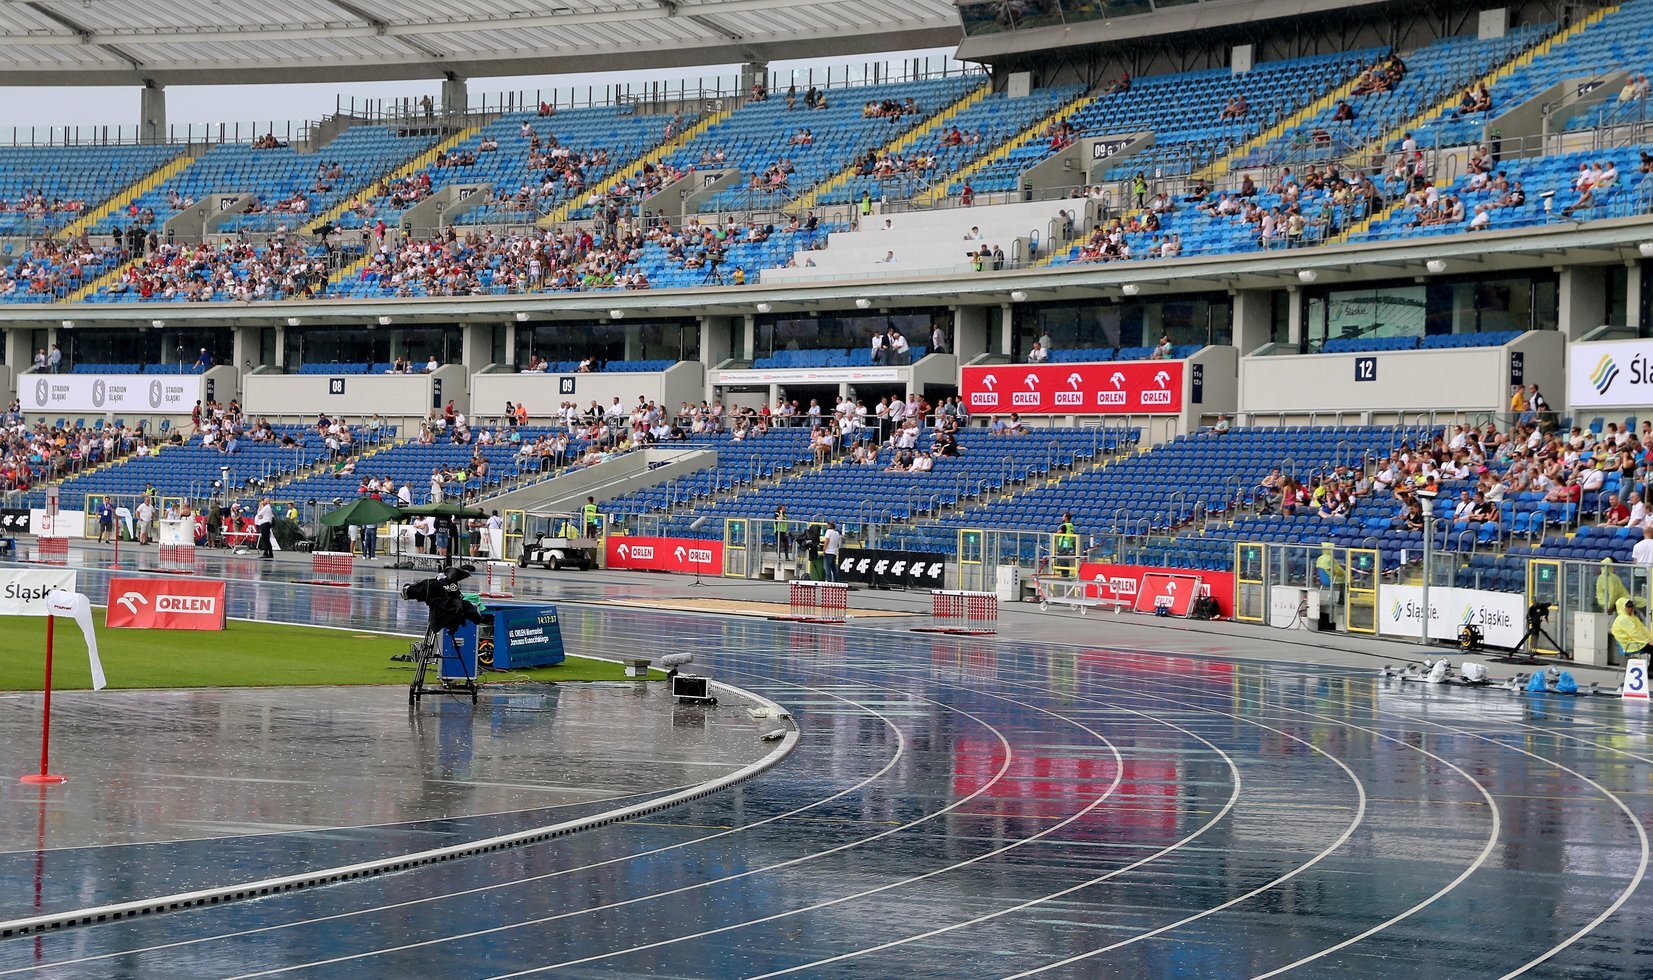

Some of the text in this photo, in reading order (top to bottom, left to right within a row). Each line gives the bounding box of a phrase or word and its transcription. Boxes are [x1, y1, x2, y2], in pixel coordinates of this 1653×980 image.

[1358, 360, 1373, 378] 12
[332, 380, 342, 392] 08
[562, 378, 573, 392] 09
[972, 394, 997, 404] ORLEN
[1013, 394, 1039, 404] ORLEN
[1056, 393, 1082, 403] ORLEN
[1099, 393, 1124, 403] ORLEN
[1142, 392, 1169, 402] ORLEN
[3, 514, 29, 527] 4F 4F
[632, 547, 653, 558] ORLEN
[689, 550, 711, 562] ORLEN
[839, 557, 871, 574] 4F 4F
[873, 559, 907, 576] 4F 4F
[909, 561, 944, 579] 4F 4F
[4, 580, 67, 603] Śląsk
[1112, 579, 1135, 592] ORLEN
[159, 597, 211, 611] ORLEN
[1155, 597, 1173, 606] ORLEN
[1479, 604, 1513, 629] Śląskie.
[1628, 666, 1644, 691] 3
